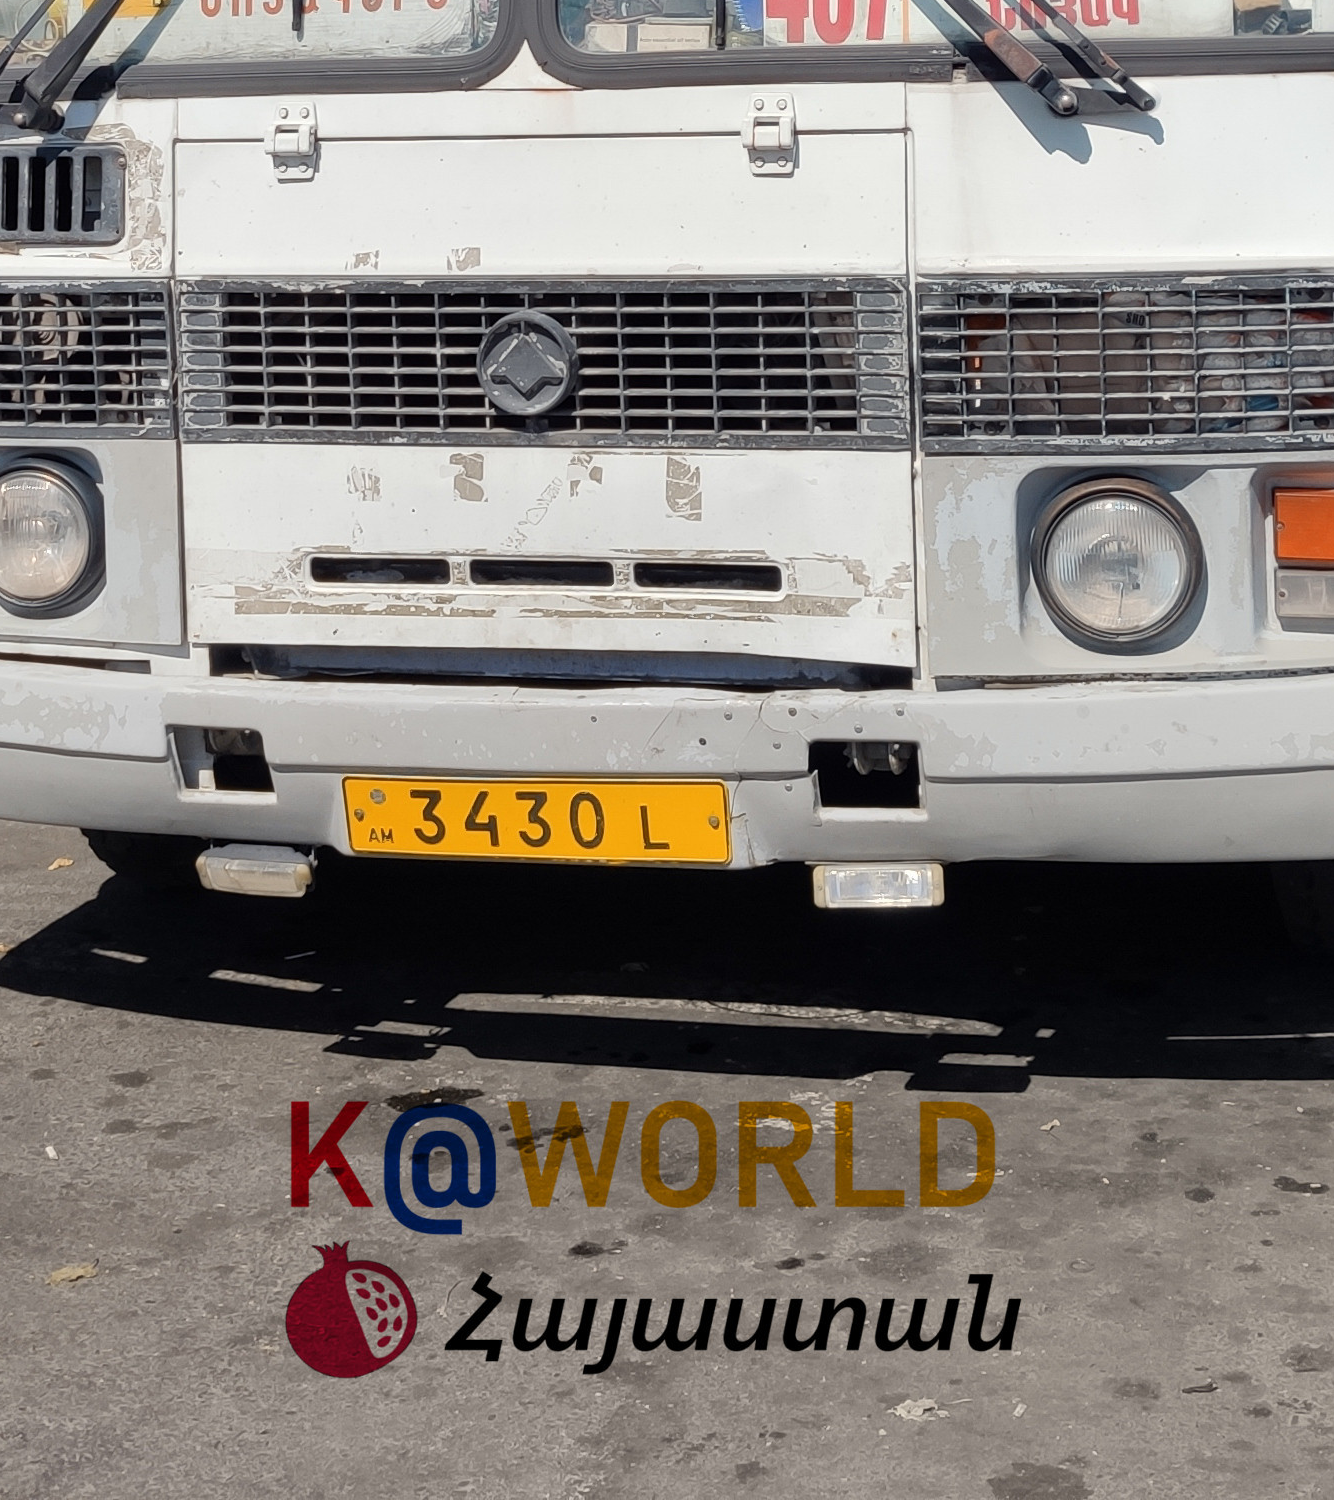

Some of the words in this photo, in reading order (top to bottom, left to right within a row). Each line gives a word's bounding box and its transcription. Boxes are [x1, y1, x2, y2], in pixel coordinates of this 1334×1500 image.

[368, 828, 395, 844] AM
[410, 789, 605, 850] 3430
[640, 805, 671, 850] L
